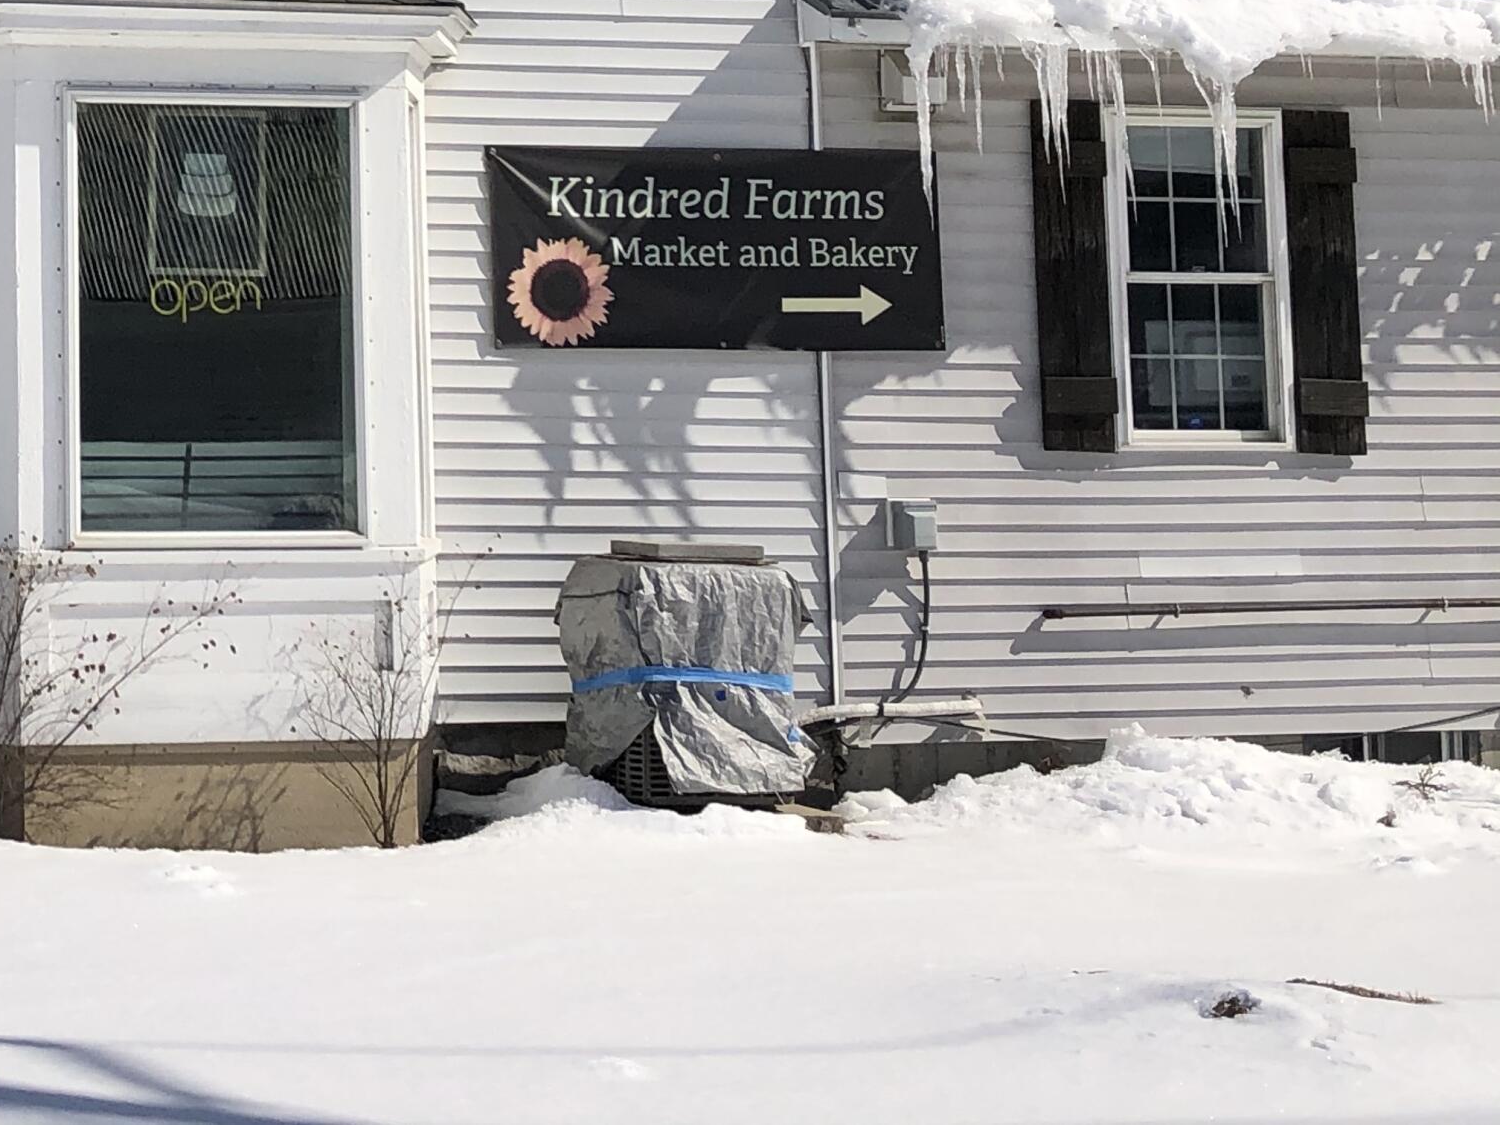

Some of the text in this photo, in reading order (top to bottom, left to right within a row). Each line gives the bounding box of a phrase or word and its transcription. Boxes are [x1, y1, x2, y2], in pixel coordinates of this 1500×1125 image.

[546, 176, 885, 221] Kindred Farms
[610, 236, 919, 275] Market and Bakery
[150, 279, 261, 323] open
